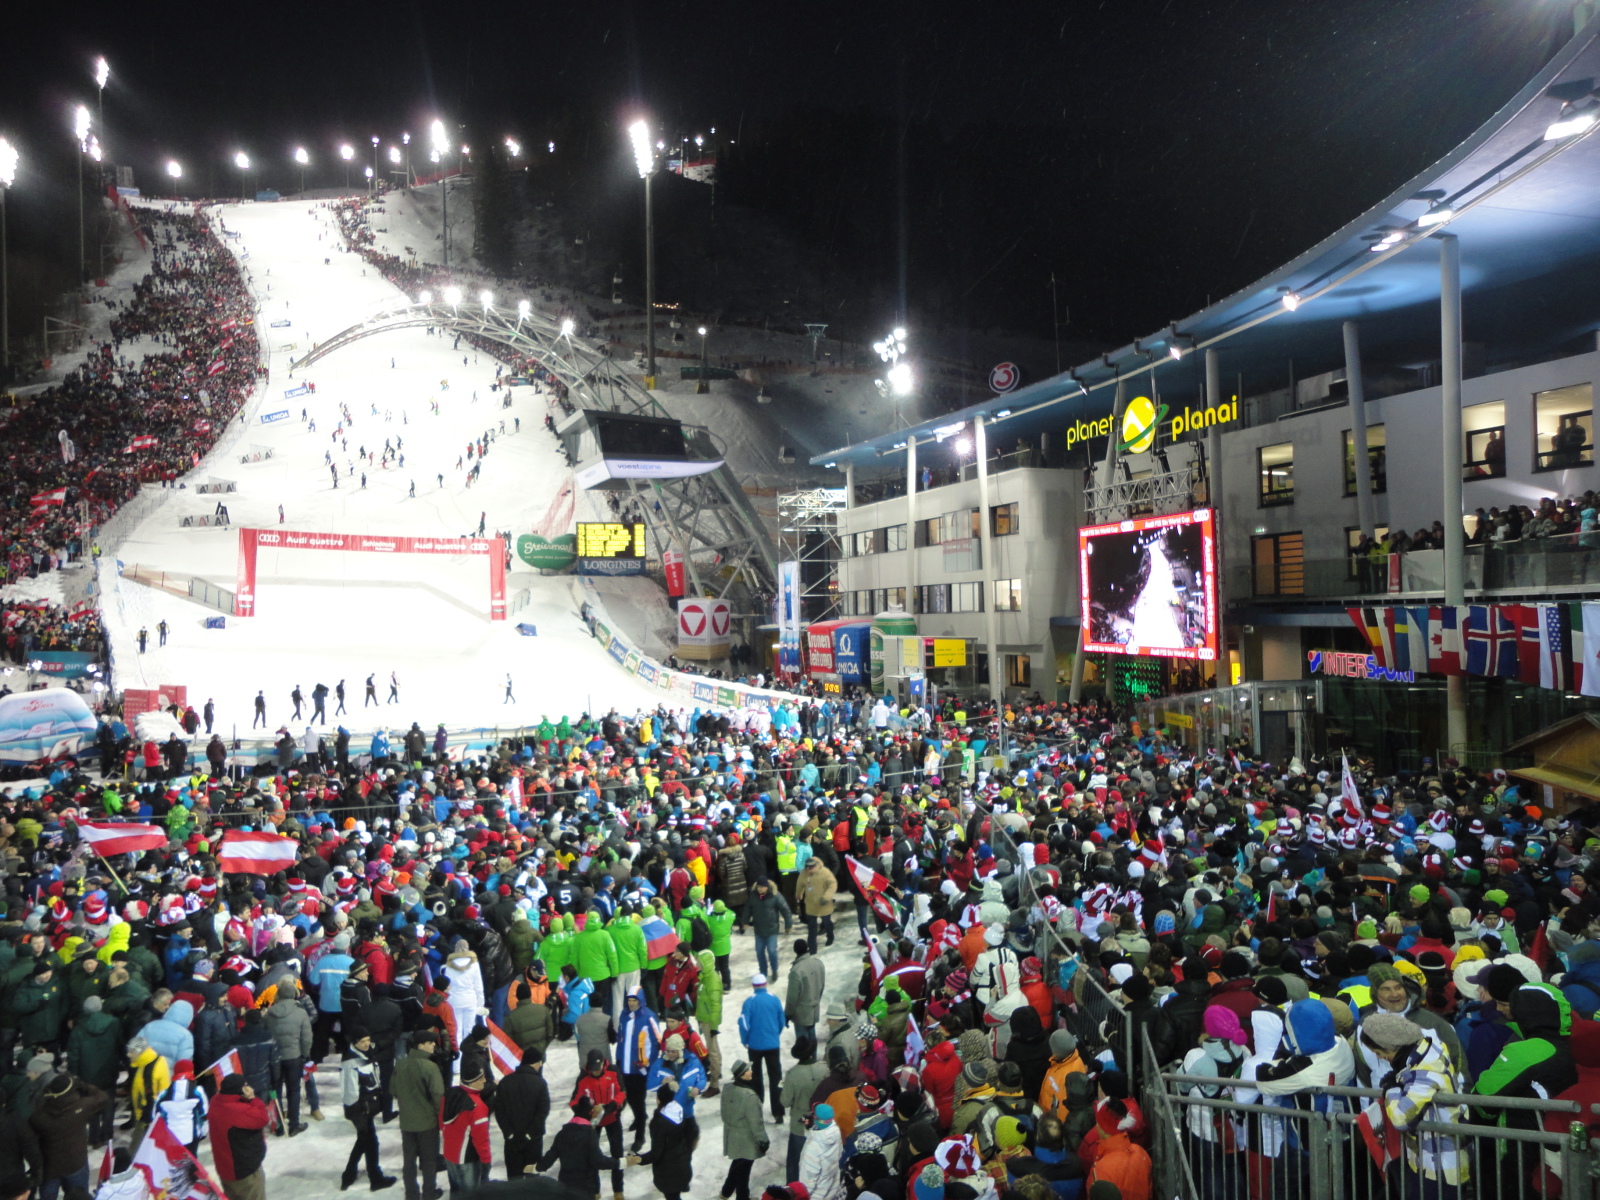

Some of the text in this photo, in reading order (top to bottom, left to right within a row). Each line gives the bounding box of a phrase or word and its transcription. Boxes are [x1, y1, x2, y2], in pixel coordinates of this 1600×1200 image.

[1066, 395, 1238, 450] planet planai
[200, 483, 234, 494] A1 A1 A1
[182, 516, 226, 526] A1 A1 A1
[286, 536, 343, 546] Audi quattro
[524, 542, 577, 554] Steiermark
[584, 561, 641, 569] LONGINES
[1323, 652, 1414, 682] INTERSPORT
[560, 890, 572, 904] 5
